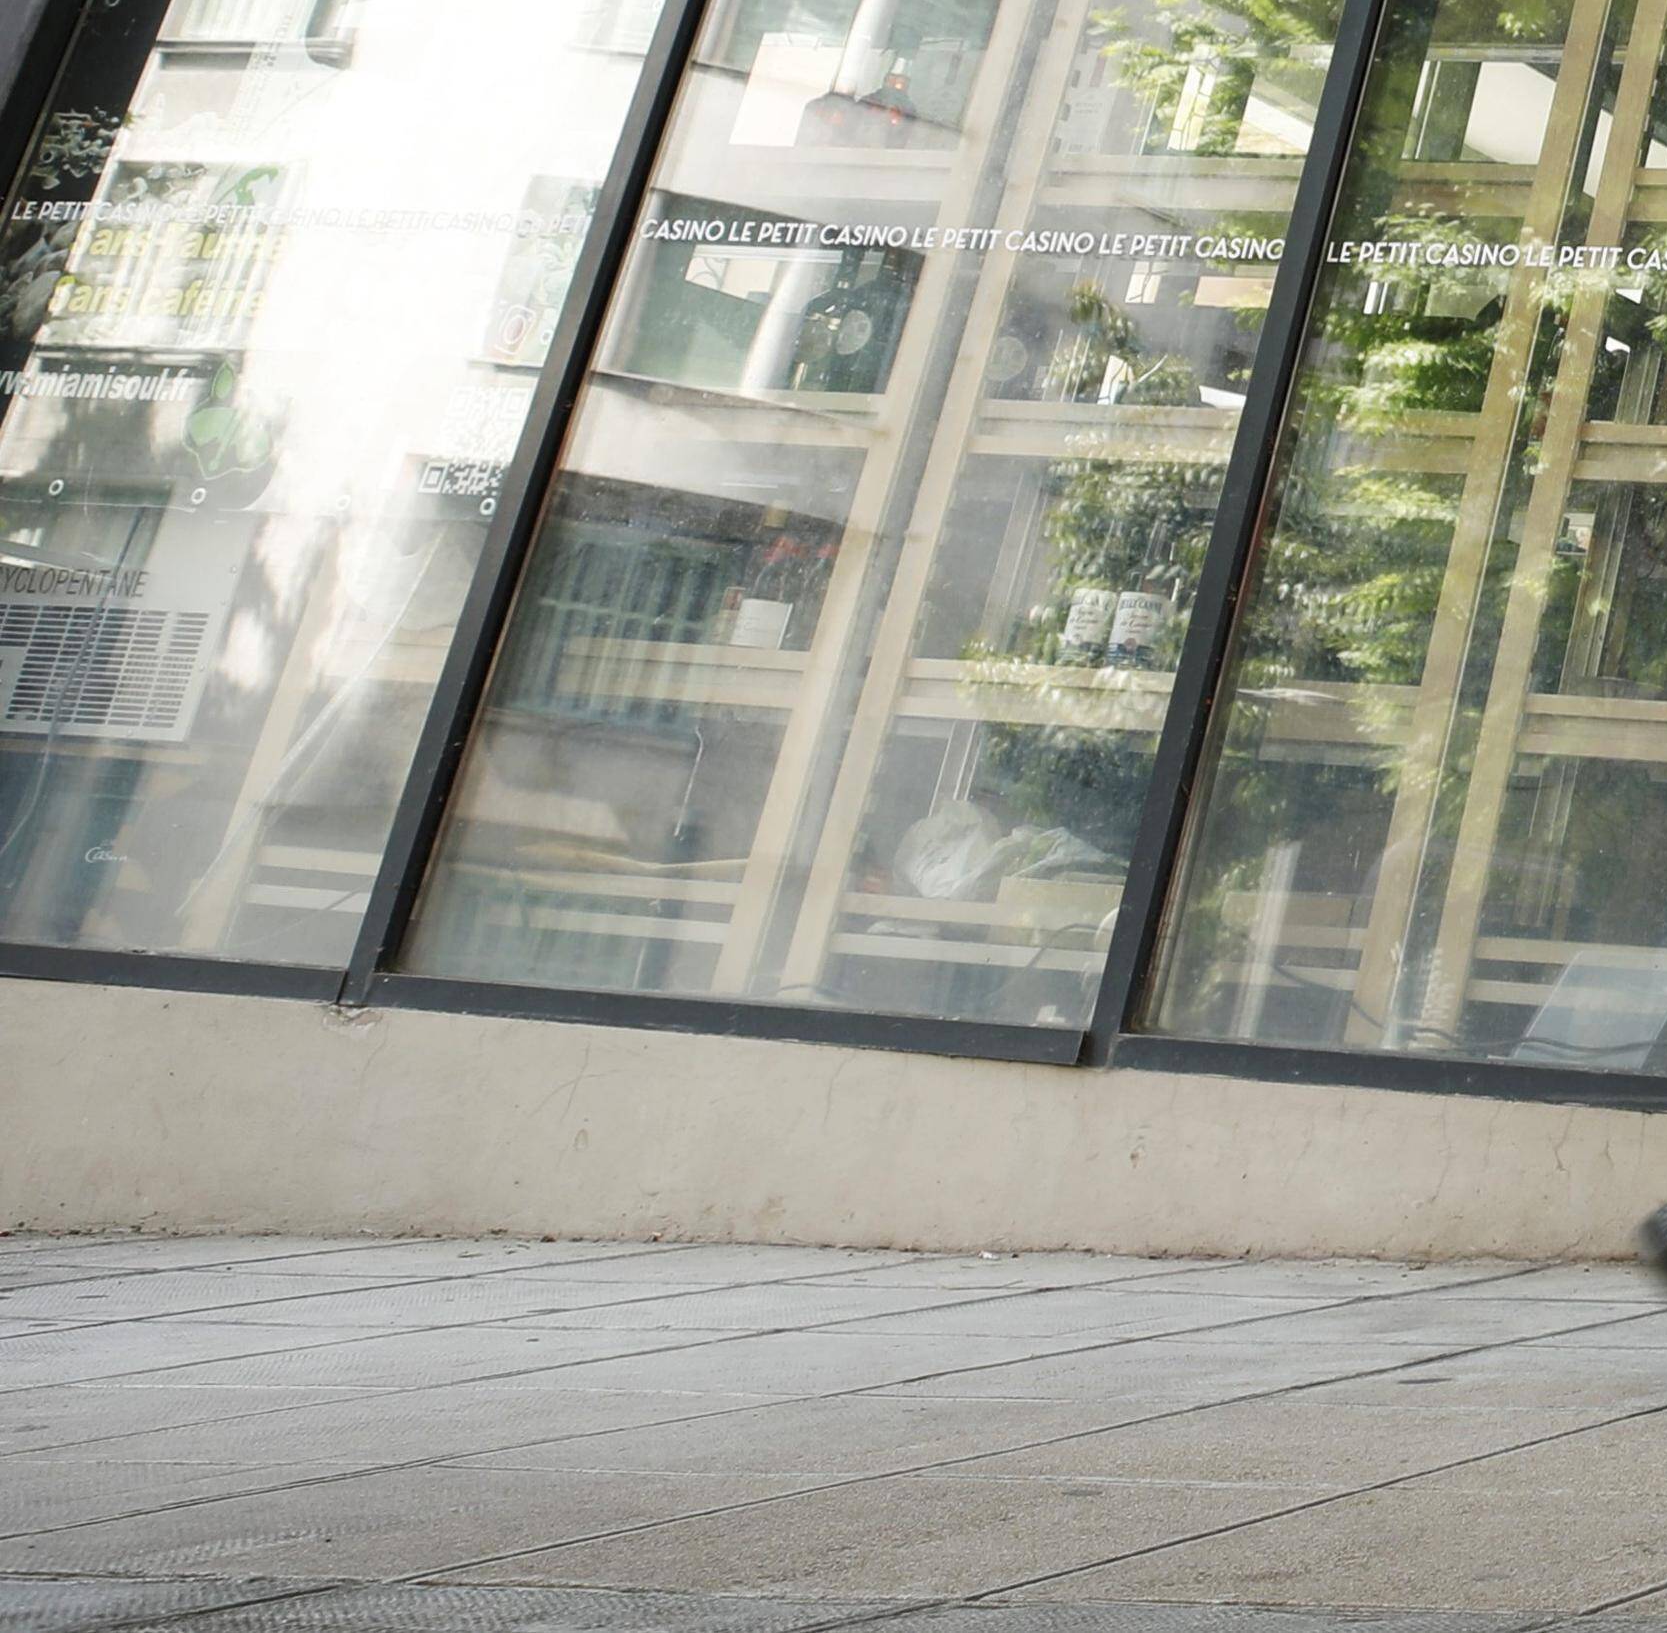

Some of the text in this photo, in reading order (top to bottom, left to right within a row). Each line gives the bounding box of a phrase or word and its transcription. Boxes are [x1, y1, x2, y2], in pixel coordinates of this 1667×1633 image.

[11, 201, 36, 220] LE
[38, 202, 93, 221] PETIT
[640, 218, 1285, 260] CASINO LE PETIT CASINO LE PETIT CASINO LE PETIT CASINO
[1327, 242, 1354, 263] LE
[1360, 242, 1422, 264] PETIT
[1424, 243, 1520, 267] CASINO
[1524, 244, 1554, 267] LE
[1559, 246, 1623, 270] PETIT
